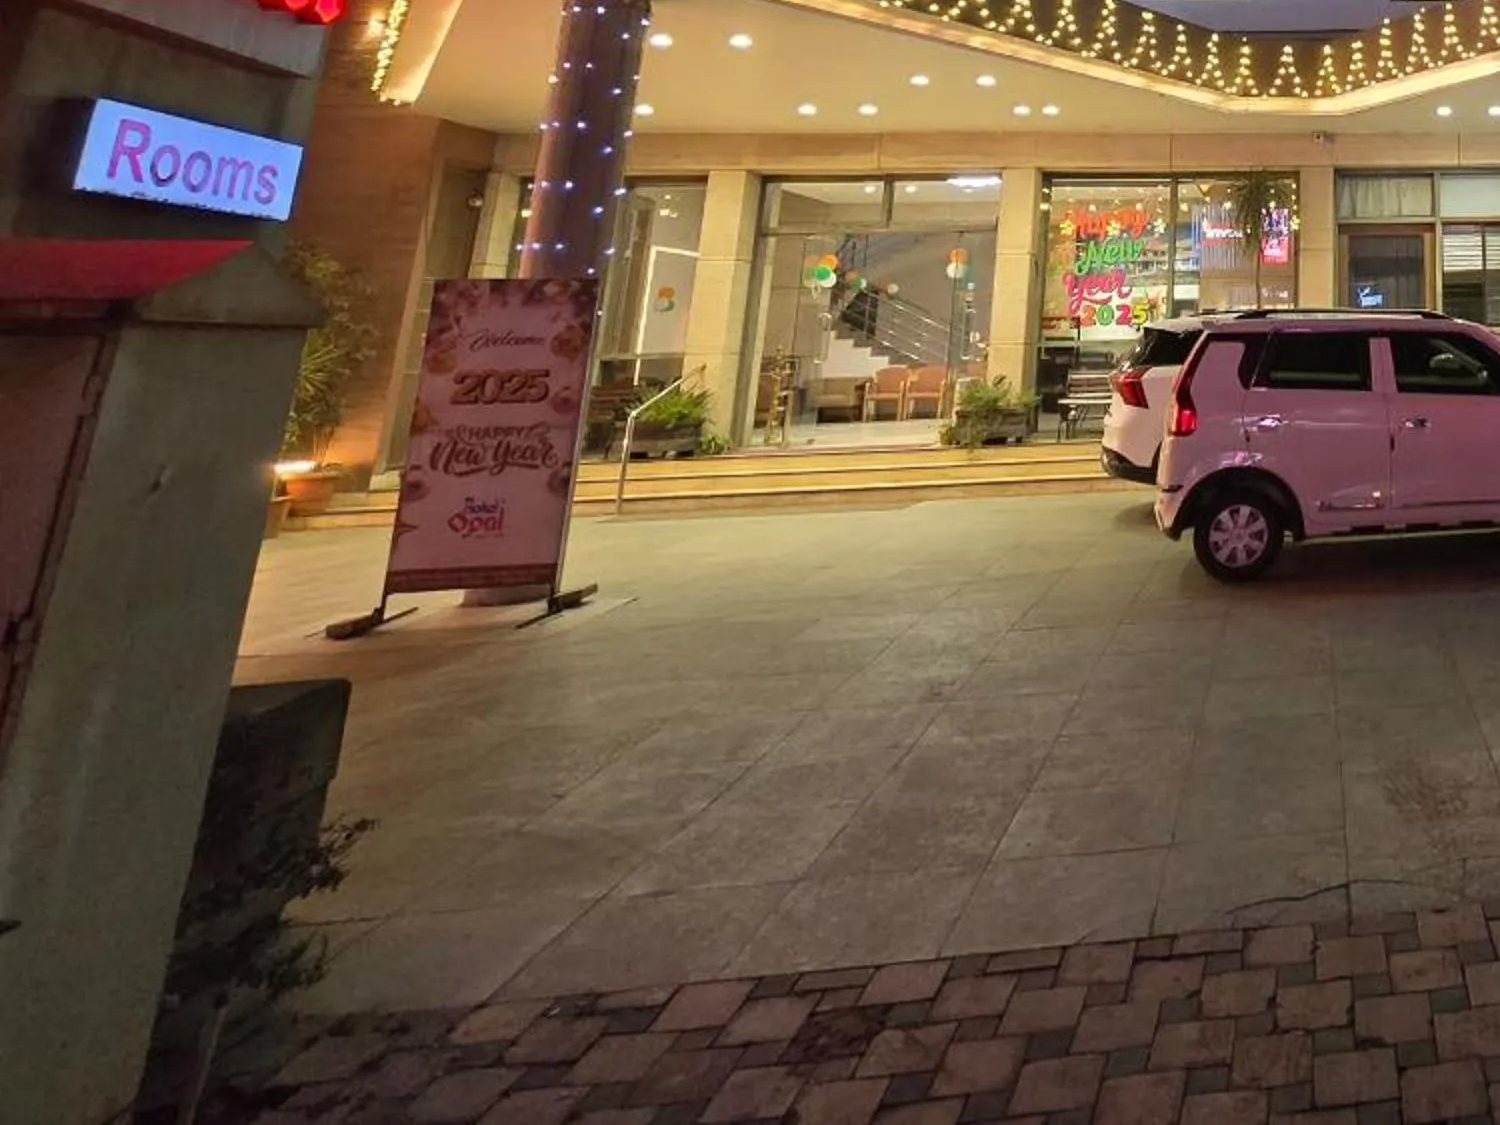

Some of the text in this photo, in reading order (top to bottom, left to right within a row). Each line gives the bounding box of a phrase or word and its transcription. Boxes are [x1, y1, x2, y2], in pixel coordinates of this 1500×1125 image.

[106, 118, 279, 206] Rooms
[1074, 236, 1146, 275] New
[1063, 269, 1133, 317] Year
[1080, 300, 1149, 328] 2025
[449, 369, 551, 405] 2025
[429, 438, 559, 477] New Year
[448, 506, 504, 539] Opal
